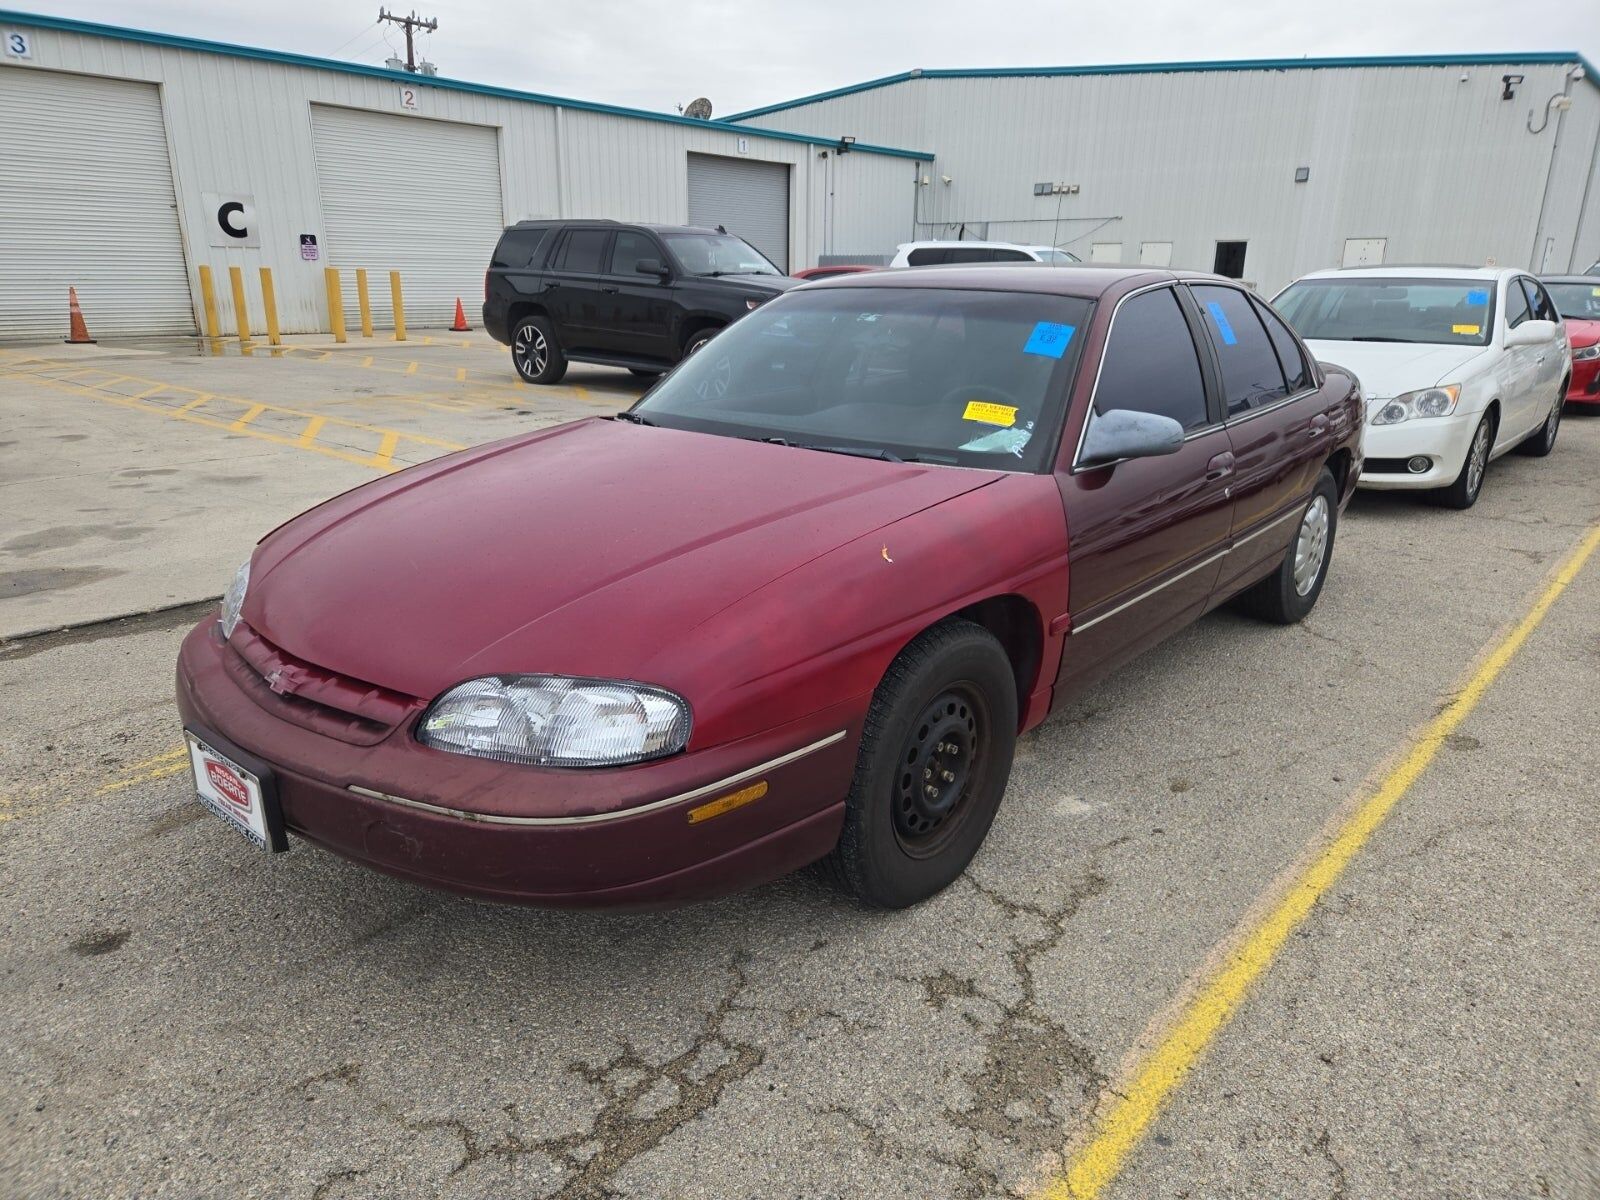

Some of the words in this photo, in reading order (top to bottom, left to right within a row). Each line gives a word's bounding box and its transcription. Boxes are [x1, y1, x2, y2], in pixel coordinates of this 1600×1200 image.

[10, 34, 26, 54] 3
[404, 90, 414, 106] 2
[217, 201, 248, 239] C
[210, 770, 248, 803] BOERNE
